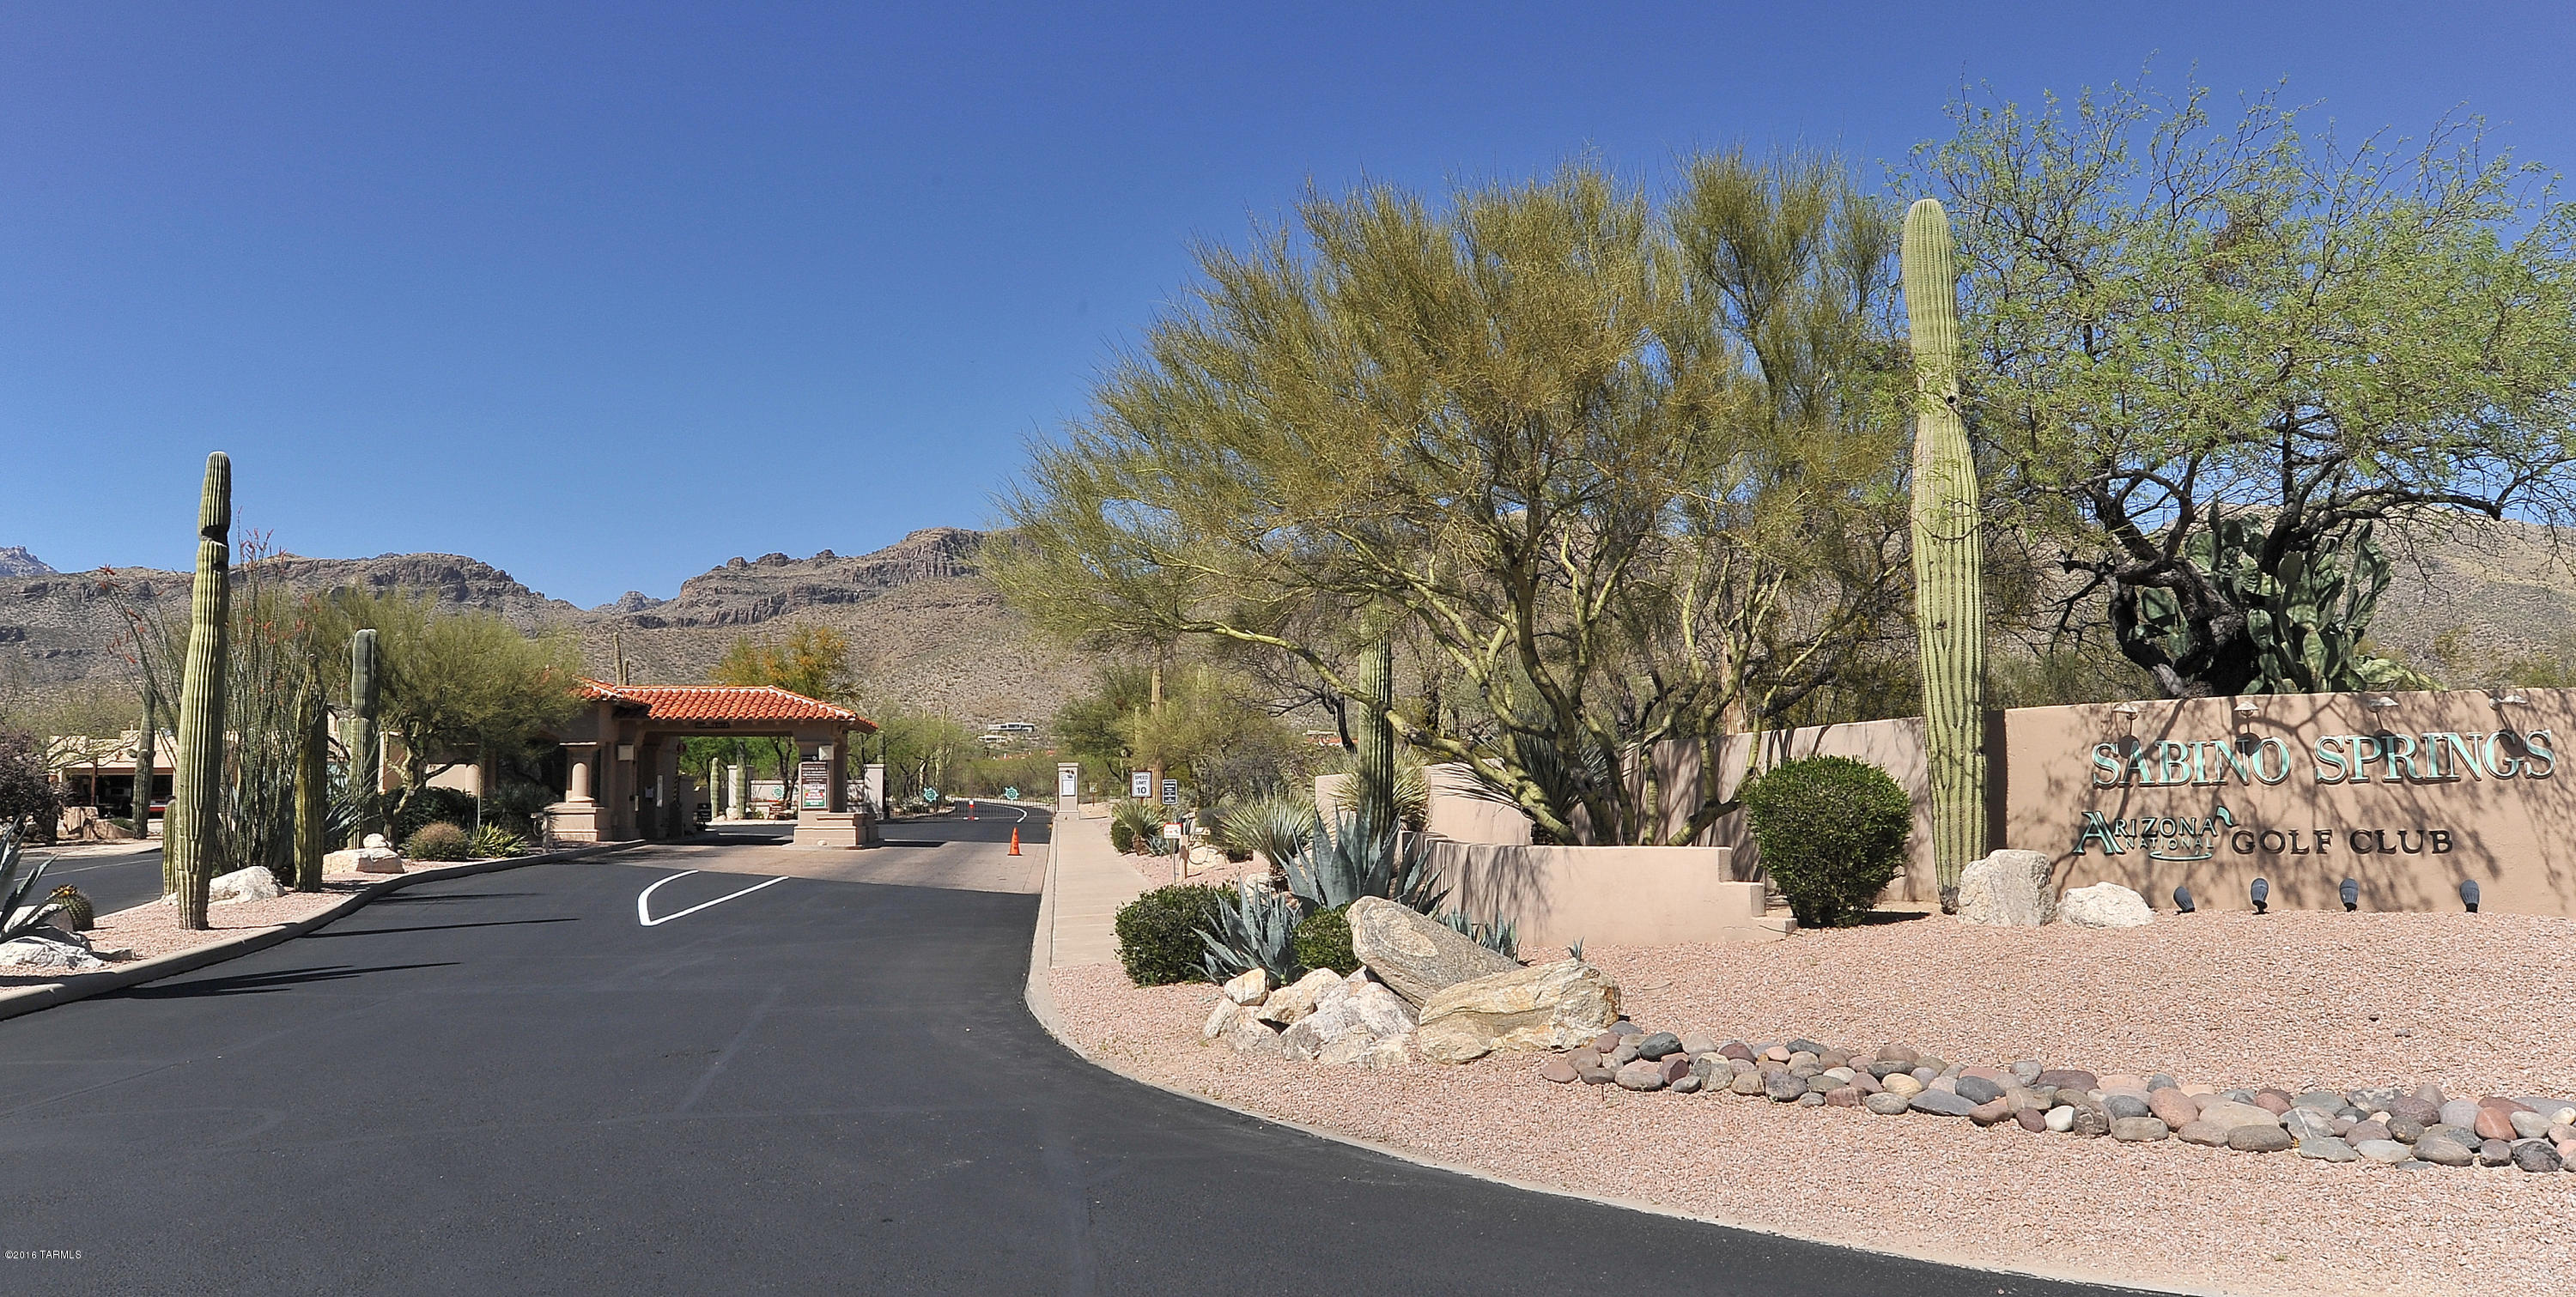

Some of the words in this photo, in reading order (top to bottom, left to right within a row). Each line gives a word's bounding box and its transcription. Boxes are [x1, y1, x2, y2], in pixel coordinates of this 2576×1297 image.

[2091, 736, 2292, 787] SABINO
[2314, 730, 2556, 784] SPRINGS
[2072, 810, 2218, 855] ARIZONA
[2124, 837, 2215, 851] NATIONAL
[2231, 829, 2333, 855] GOLF
[2348, 828, 2454, 855] CLUB
